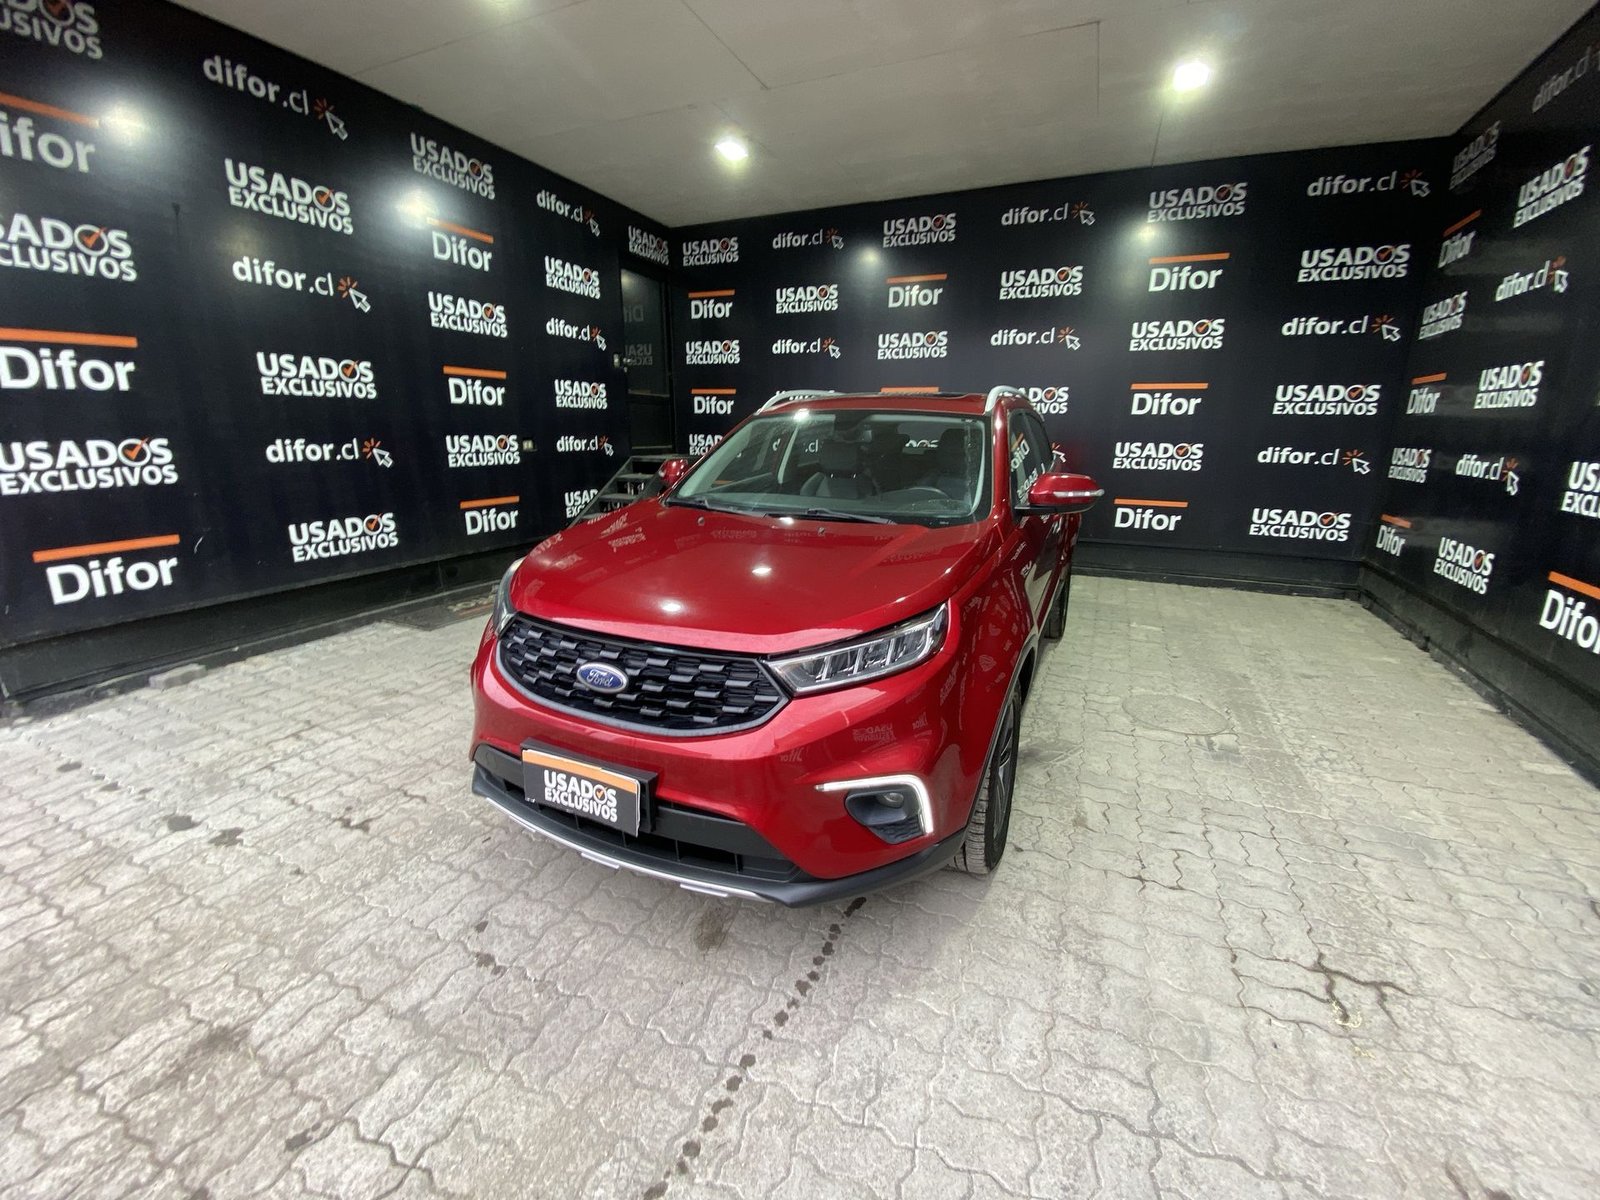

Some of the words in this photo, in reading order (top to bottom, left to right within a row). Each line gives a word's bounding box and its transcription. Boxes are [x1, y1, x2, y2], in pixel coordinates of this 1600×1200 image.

[203, 55, 309, 115] difor.cl
[411, 133, 494, 183] USADOS
[225, 158, 350, 216] USADOS
[413, 156, 495, 199] EXCLUSIVOS
[1307, 171, 1398, 197] difor.cl
[537, 190, 583, 223] difor.cl
[1150, 182, 1248, 209] USADOS
[228, 186, 354, 235] EXCLUSIVOS
[1001, 203, 1068, 226] difor.cl
[1147, 201, 1246, 223] EXCLUSIVOS
[883, 213, 956, 235] USADOS
[0, 213, 132, 259] ADOS
[683, 237, 738, 255] USADOS
[773, 229, 823, 249] difor.cl
[883, 230, 956, 248] EXCLUSIVOS
[432, 231, 492, 271] Difor
[683, 251, 739, 266] EXCLUSIVOS
[1301, 244, 1411, 268] USADOS
[232, 256, 334, 296] difor.cl
[545, 256, 599, 286] USADOS
[1000, 266, 1083, 287] USADOS
[1148, 265, 1223, 292] Difor
[1297, 263, 1408, 282] EXCLUSIVOS
[545, 274, 600, 299] EXCLUSIVOS
[776, 284, 838, 302] USADOS
[888, 285, 943, 308] Difor
[999, 283, 1082, 300] EXCLUSIVOS
[428, 292, 506, 323] USADOS
[691, 299, 732, 319] Difor
[776, 300, 838, 314] EXCLUSIVOS
[430, 312, 508, 338] EXCLUSIVOS
[546, 318, 590, 342] difor.cl
[990, 327, 1055, 346] difor.cl
[1132, 318, 1225, 339] USADOS
[1281, 316, 1369, 336] difor.cl
[686, 340, 739, 354] USADOS
[772, 338, 820, 354] difor.cl
[878, 331, 948, 348] USADOS
[1129, 336, 1223, 351] EXCLUSIVOS
[686, 352, 740, 364] EXCLUSIVOS
[877, 346, 947, 360] EXCLUSIVOS
[0, 346, 135, 391] Difor
[256, 352, 374, 382] USADOS
[1479, 360, 1545, 390] USADOS
[260, 377, 377, 399] EXCLUSIVOS
[448, 378, 506, 406] Difor
[555, 380, 606, 398] USADOS
[1275, 384, 1381, 403] USADOS
[556, 396, 607, 409] EXCLUSIVOS
[694, 396, 734, 414] Difor
[1131, 393, 1202, 416] Difor
[1272, 400, 1378, 416] EXCLUSIVOS
[1406, 387, 1440, 414] Difor
[0, 438, 173, 472] USADOS
[266, 438, 359, 463] difor.cl
[446, 435, 518, 453] USADOS
[557, 436, 598, 452] difor.cl
[1115, 442, 1204, 459] USADOS
[448, 452, 520, 467] EXCLUSIVOS
[1112, 457, 1202, 471] EXCLUSIVOS
[1257, 447, 1340, 466] difor.cl
[1392, 448, 1432, 468] USADOS
[1455, 454, 1504, 481] difor.cl
[0, 464, 178, 495] EXCLUSIVOS
[1569, 461, 1600, 493] US
[1561, 491, 1600, 519] EXCL
[288, 512, 396, 546] USADOS
[465, 509, 518, 535] Difor
[1114, 507, 1182, 531] Difor
[1252, 508, 1352, 529] USADOS
[1249, 524, 1349, 542] EXCLUSIVOS
[1376, 525, 1405, 556] Difor
[292, 532, 399, 563] EXCLUSIVOS
[1439, 537, 1495, 576] USADOS
[46, 557, 178, 605] Difor
[1433, 558, 1489, 594] EXCLUSIVOS
[587, 669, 613, 687] Ford
[544, 770, 617, 808] USADOS
[544, 787, 618, 822] EXCLUSIVOS
